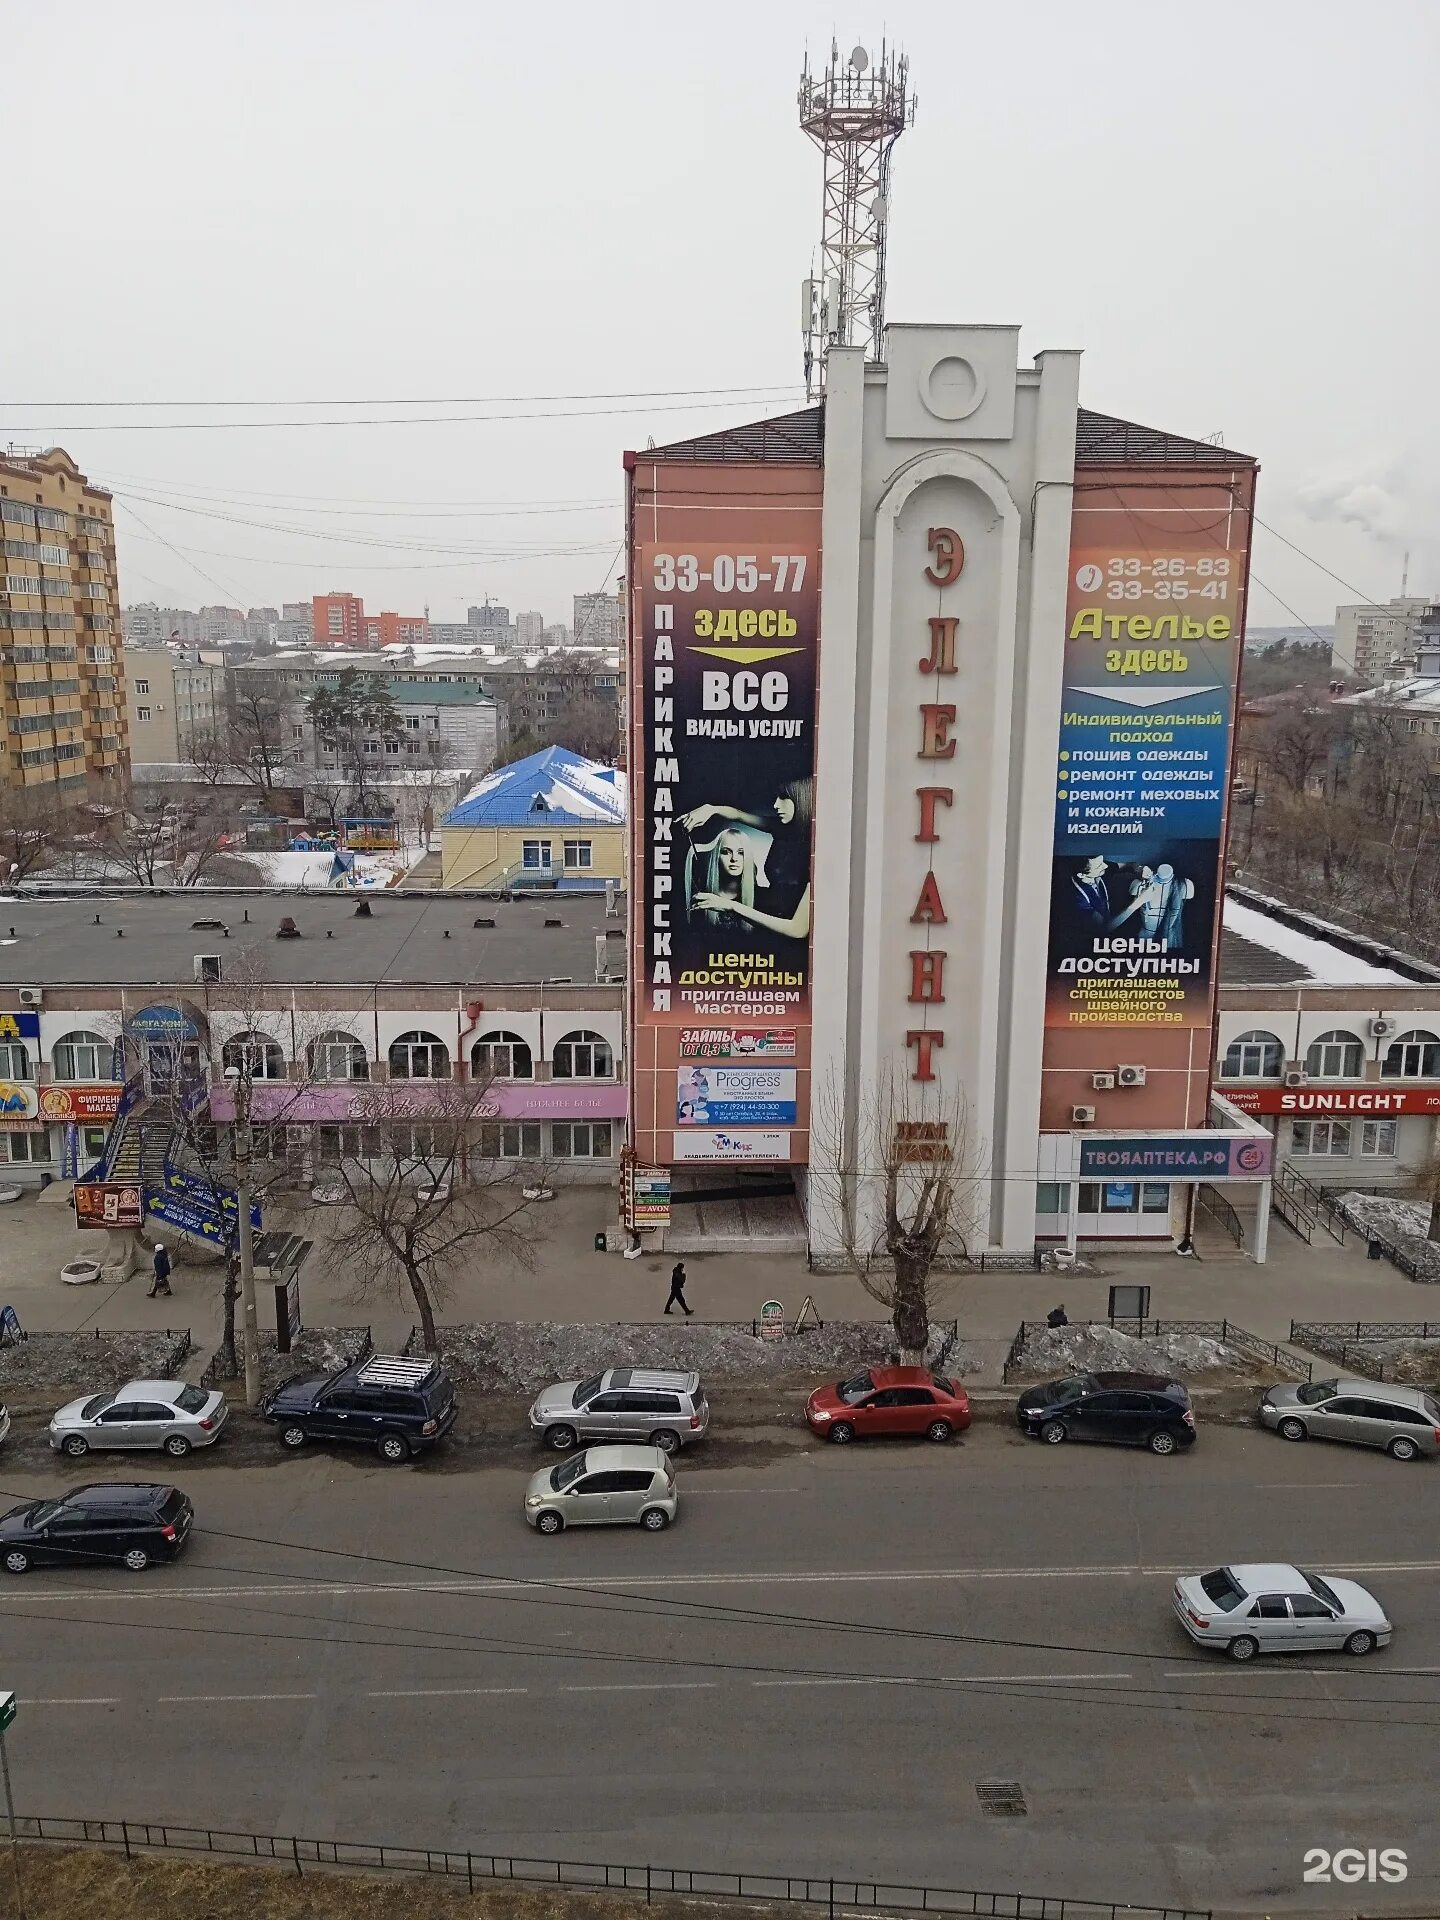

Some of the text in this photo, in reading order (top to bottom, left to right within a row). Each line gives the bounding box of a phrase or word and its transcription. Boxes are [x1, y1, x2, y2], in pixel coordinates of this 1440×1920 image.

[653, 553, 807, 593] 33-05-77
[1107, 558, 1230, 576] 33-26-83
[1106, 580, 1228, 600] 33-35-41
[1069, 607, 1231, 640] Ателье
[1063, 711, 1222, 728] Индивидуальный
[686, 719, 804, 740] виды услуг
[1109, 732, 1173, 743] подход
[1072, 750, 1208, 761] пошив одежды
[1070, 769, 1213, 783] ремонт одежды
[1069, 789, 1219, 802] ремонт меховых
[652, 604, 680, 1012] ПАРИКМАХЕРСКАЯ
[907, 527, 965, 1080] ЭЛЕГАНТ
[1068, 806, 1165, 817] и кожаных
[1067, 820, 1143, 834] изделий
[1093, 937, 1168, 954] цены
[708, 953, 774, 968] цены
[1057, 957, 1200, 977] доступны
[678, 971, 803, 989] доступны
[1077, 978, 1179, 990] приглашаем
[681, 990, 800, 1003] приглашаем
[1069, 989, 1185, 1000] специалистов
[694, 1003, 786, 1016] мастеров
[1087, 998, 1167, 1011] швейного
[1069, 1011, 1183, 1023] производства
[681, 1029, 737, 1043] ЗАЙМЫ
[683, 1044, 700, 1056] ОТ
[716, 1071, 781, 1090] Progress
[86, 1103, 119, 1112] МАГАЗ
[1281, 1094, 1407, 1109] SUNLIGHT
[1426, 1097, 1440, 1106] ЛО
[1085, 1151, 1226, 1165] ТВОЯАПТЕКА.РФ
